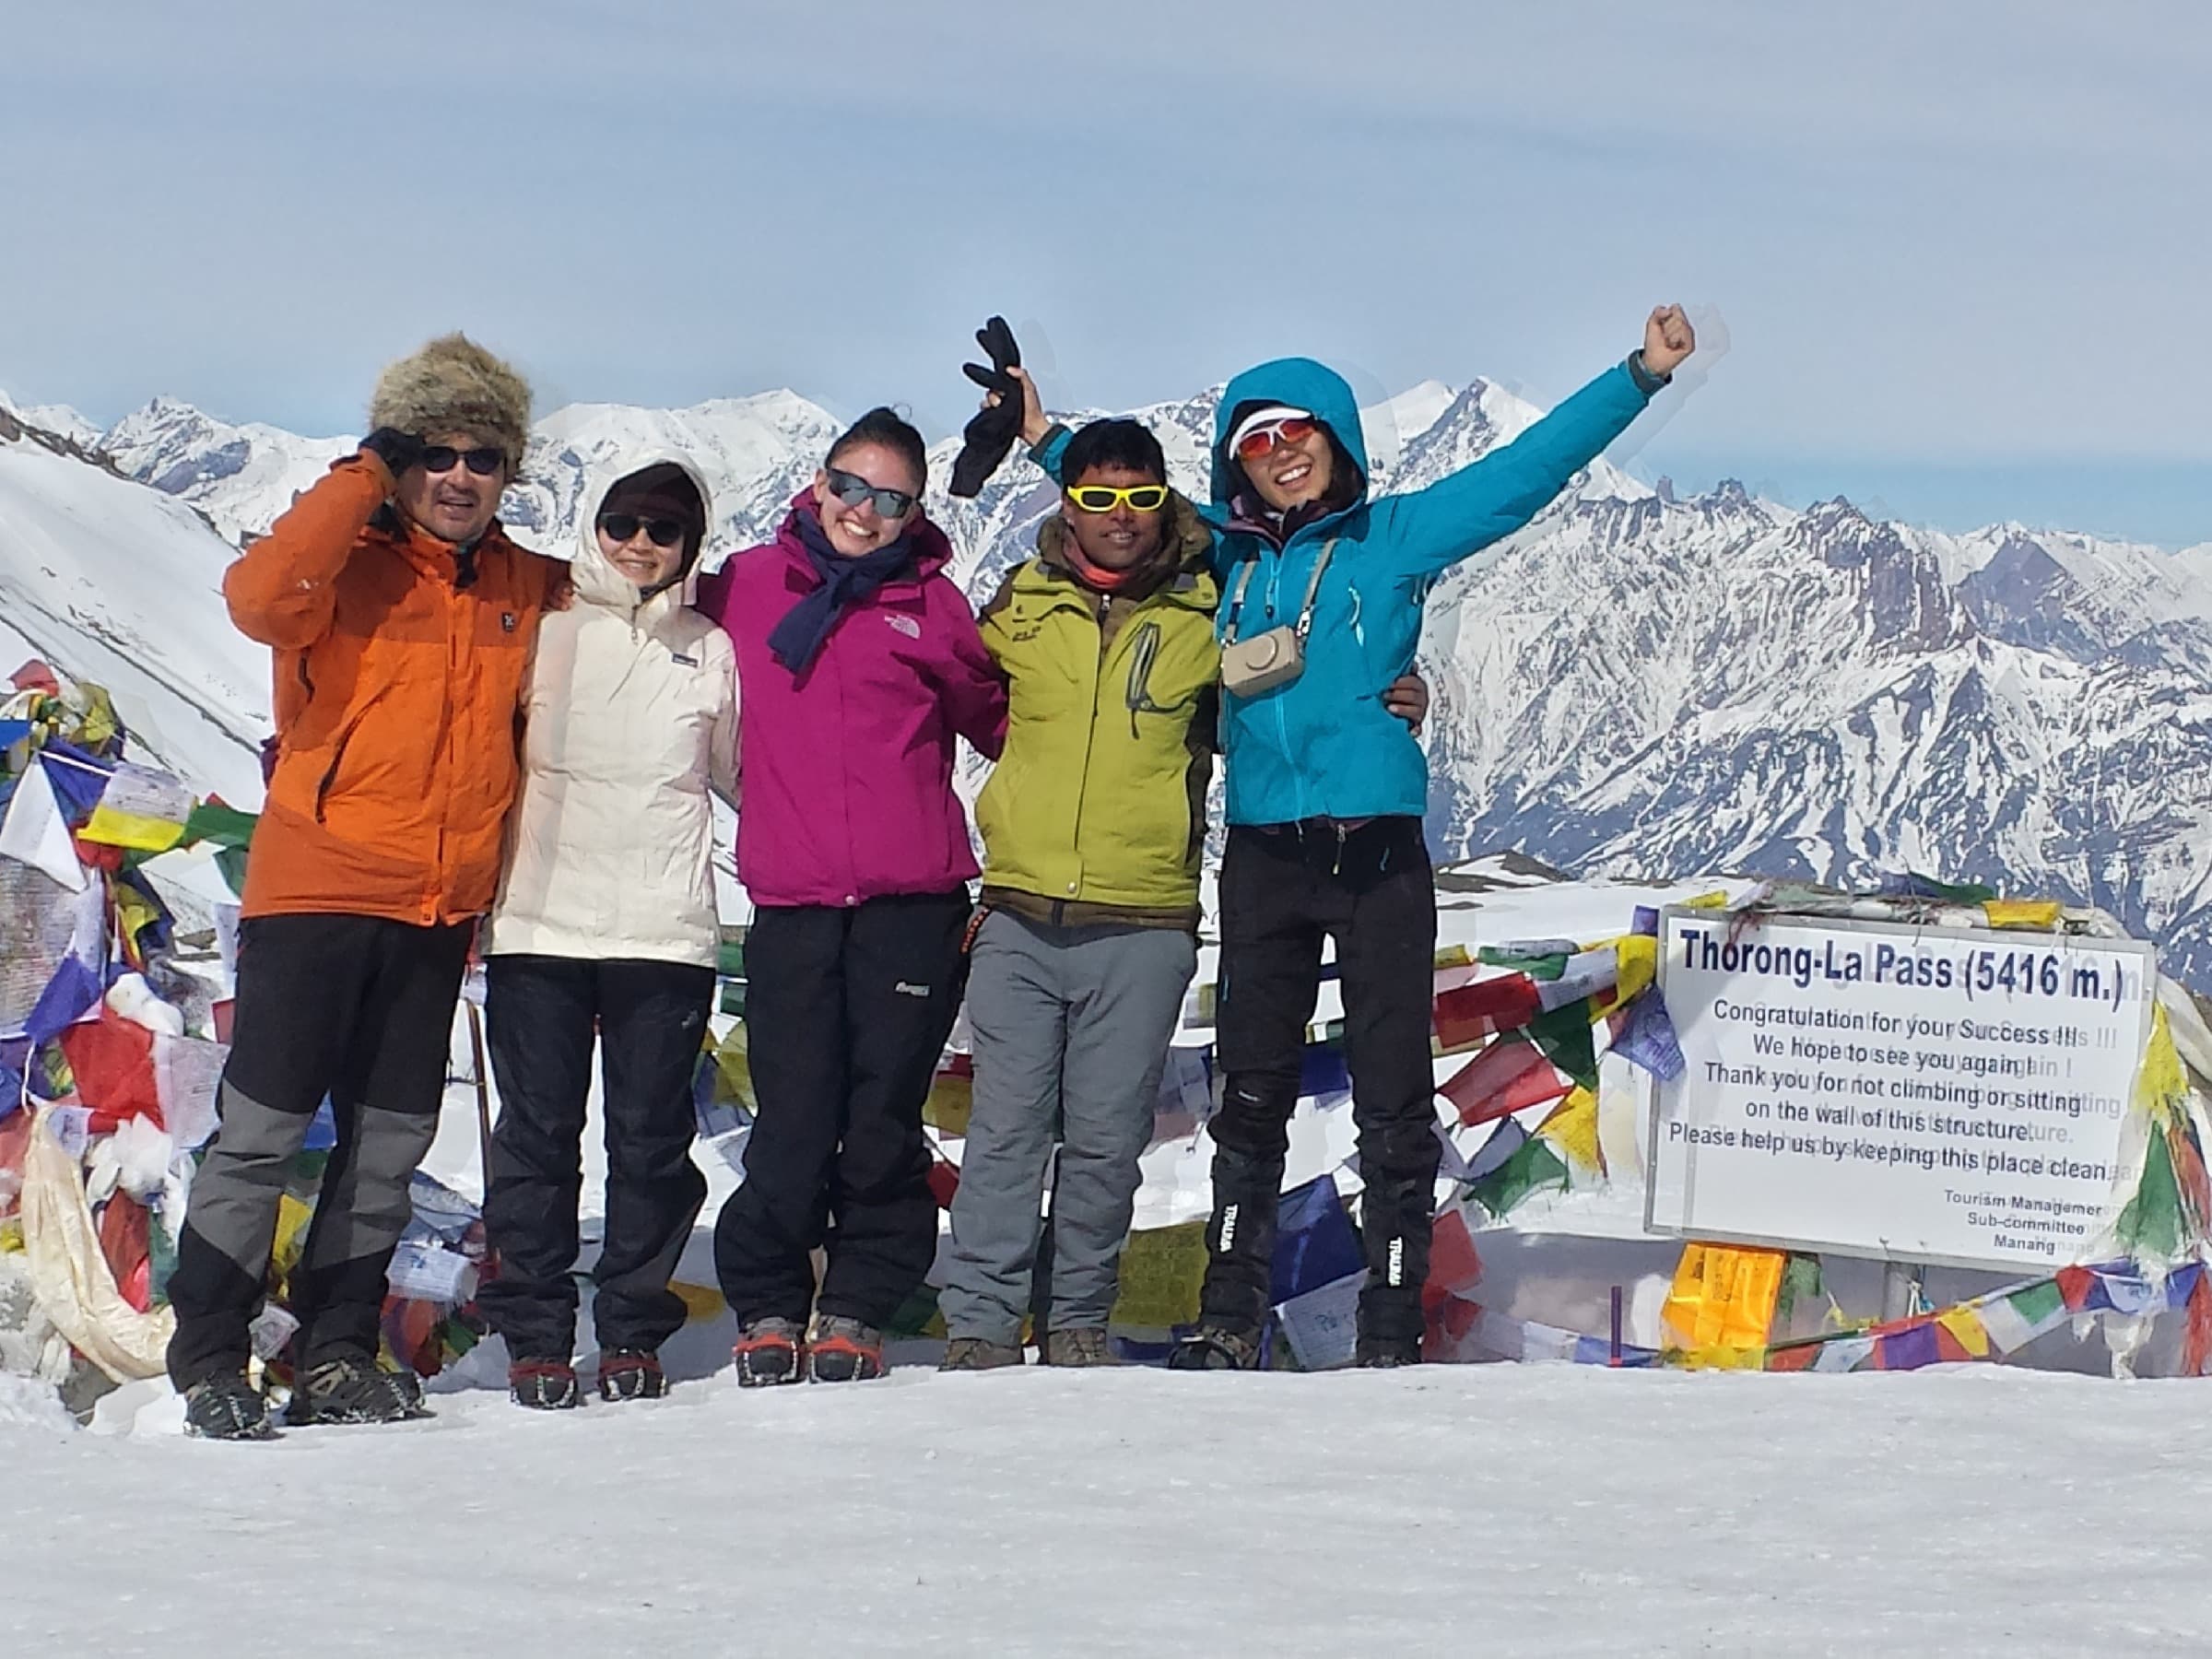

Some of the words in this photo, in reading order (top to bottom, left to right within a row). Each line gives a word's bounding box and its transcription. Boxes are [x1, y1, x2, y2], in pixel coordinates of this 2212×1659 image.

[1679, 928, 1862, 989] Thorong-La
[1875, 942, 1953, 989] Pass
[1964, 948, 2059, 1003] (5416
[2071, 958, 2123, 1014] m.)
[1712, 998, 1865, 1030] Congratulation
[1871, 1010, 1900, 1033] for
[1906, 1016, 1955, 1041] your
[1959, 1018, 2050, 1045] Success
[1752, 1033, 1785, 1055] We
[1791, 1035, 1841, 1065] hope
[1847, 1041, 1868, 1061] to
[1874, 1047, 1911, 1065] see
[1915, 1050, 1955, 1073] you
[1960, 1053, 2019, 1077] again
[1704, 1061, 1766, 1087] Thank
[1771, 1071, 1809, 1093] you
[1816, 1069, 1844, 1093] for
[1850, 1075, 1885, 1098] not
[1889, 1077, 1980, 1111] climbing
[1986, 1089, 2008, 1107] or
[2014, 1088, 2082, 1118] sitting
[1745, 1101, 1771, 1118] on
[1777, 1100, 1808, 1122] the
[1815, 1104, 1854, 1126] wall
[1862, 1108, 1882, 1128] of
[1888, 1108, 1925, 1133] this
[1932, 1115, 2035, 1143] structure.
[1669, 1122, 1735, 1147] Please
[1741, 1127, 1785, 1157] help
[1791, 1135, 1816, 1154] us
[1821, 1135, 1848, 1162] by
[1853, 1136, 1935, 1171] keeping
[1941, 1145, 1980, 1170] this
[1985, 1149, 2043, 1176] place
[1944, 1188, 2006, 1206] Tourism
[1994, 1233, 2056, 1255] Manang
